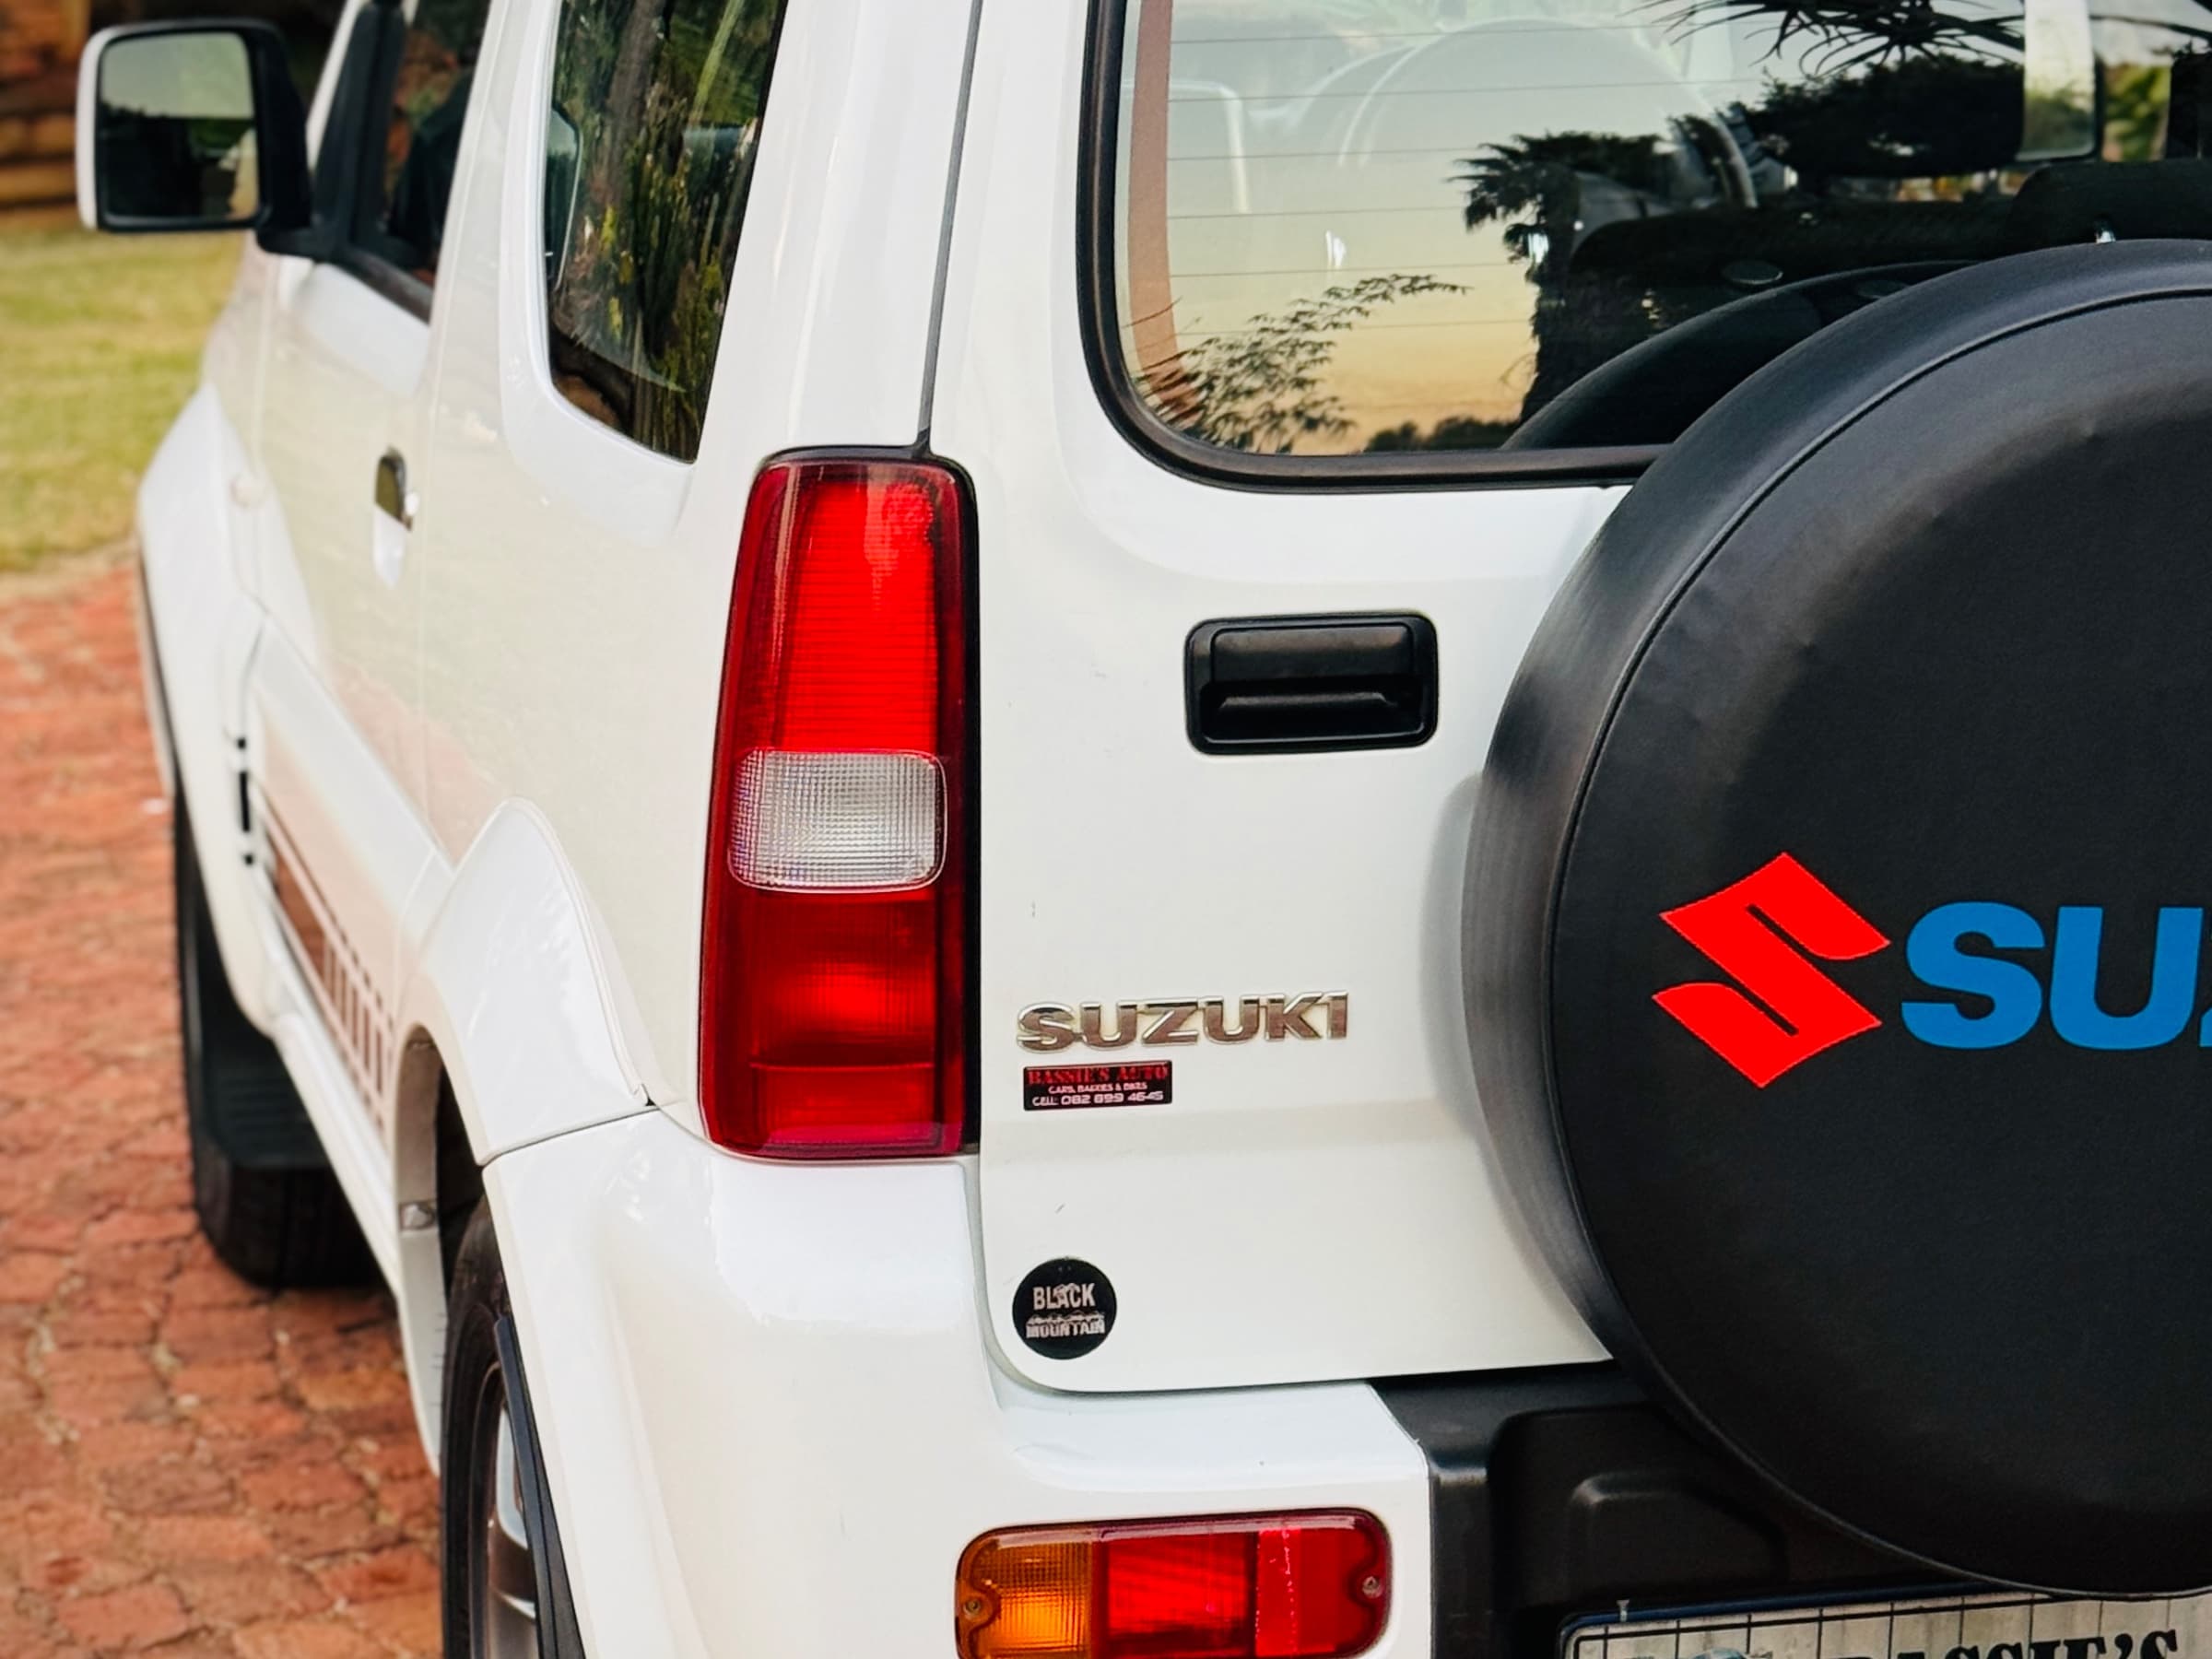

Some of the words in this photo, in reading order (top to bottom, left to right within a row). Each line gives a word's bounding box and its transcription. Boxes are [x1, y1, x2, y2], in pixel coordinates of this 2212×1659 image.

[1901, 900, 2212, 1051] SU
[1017, 990, 1349, 1053] SUZUKI
[1028, 1066, 1110, 1084] BASSIE'S
[1117, 1065, 1168, 1080] AUTO
[1061, 1094, 1090, 1105] 082
[1033, 1283, 1096, 1310] BLACK
[1025, 1317, 1105, 1338] MOUNTAIN
